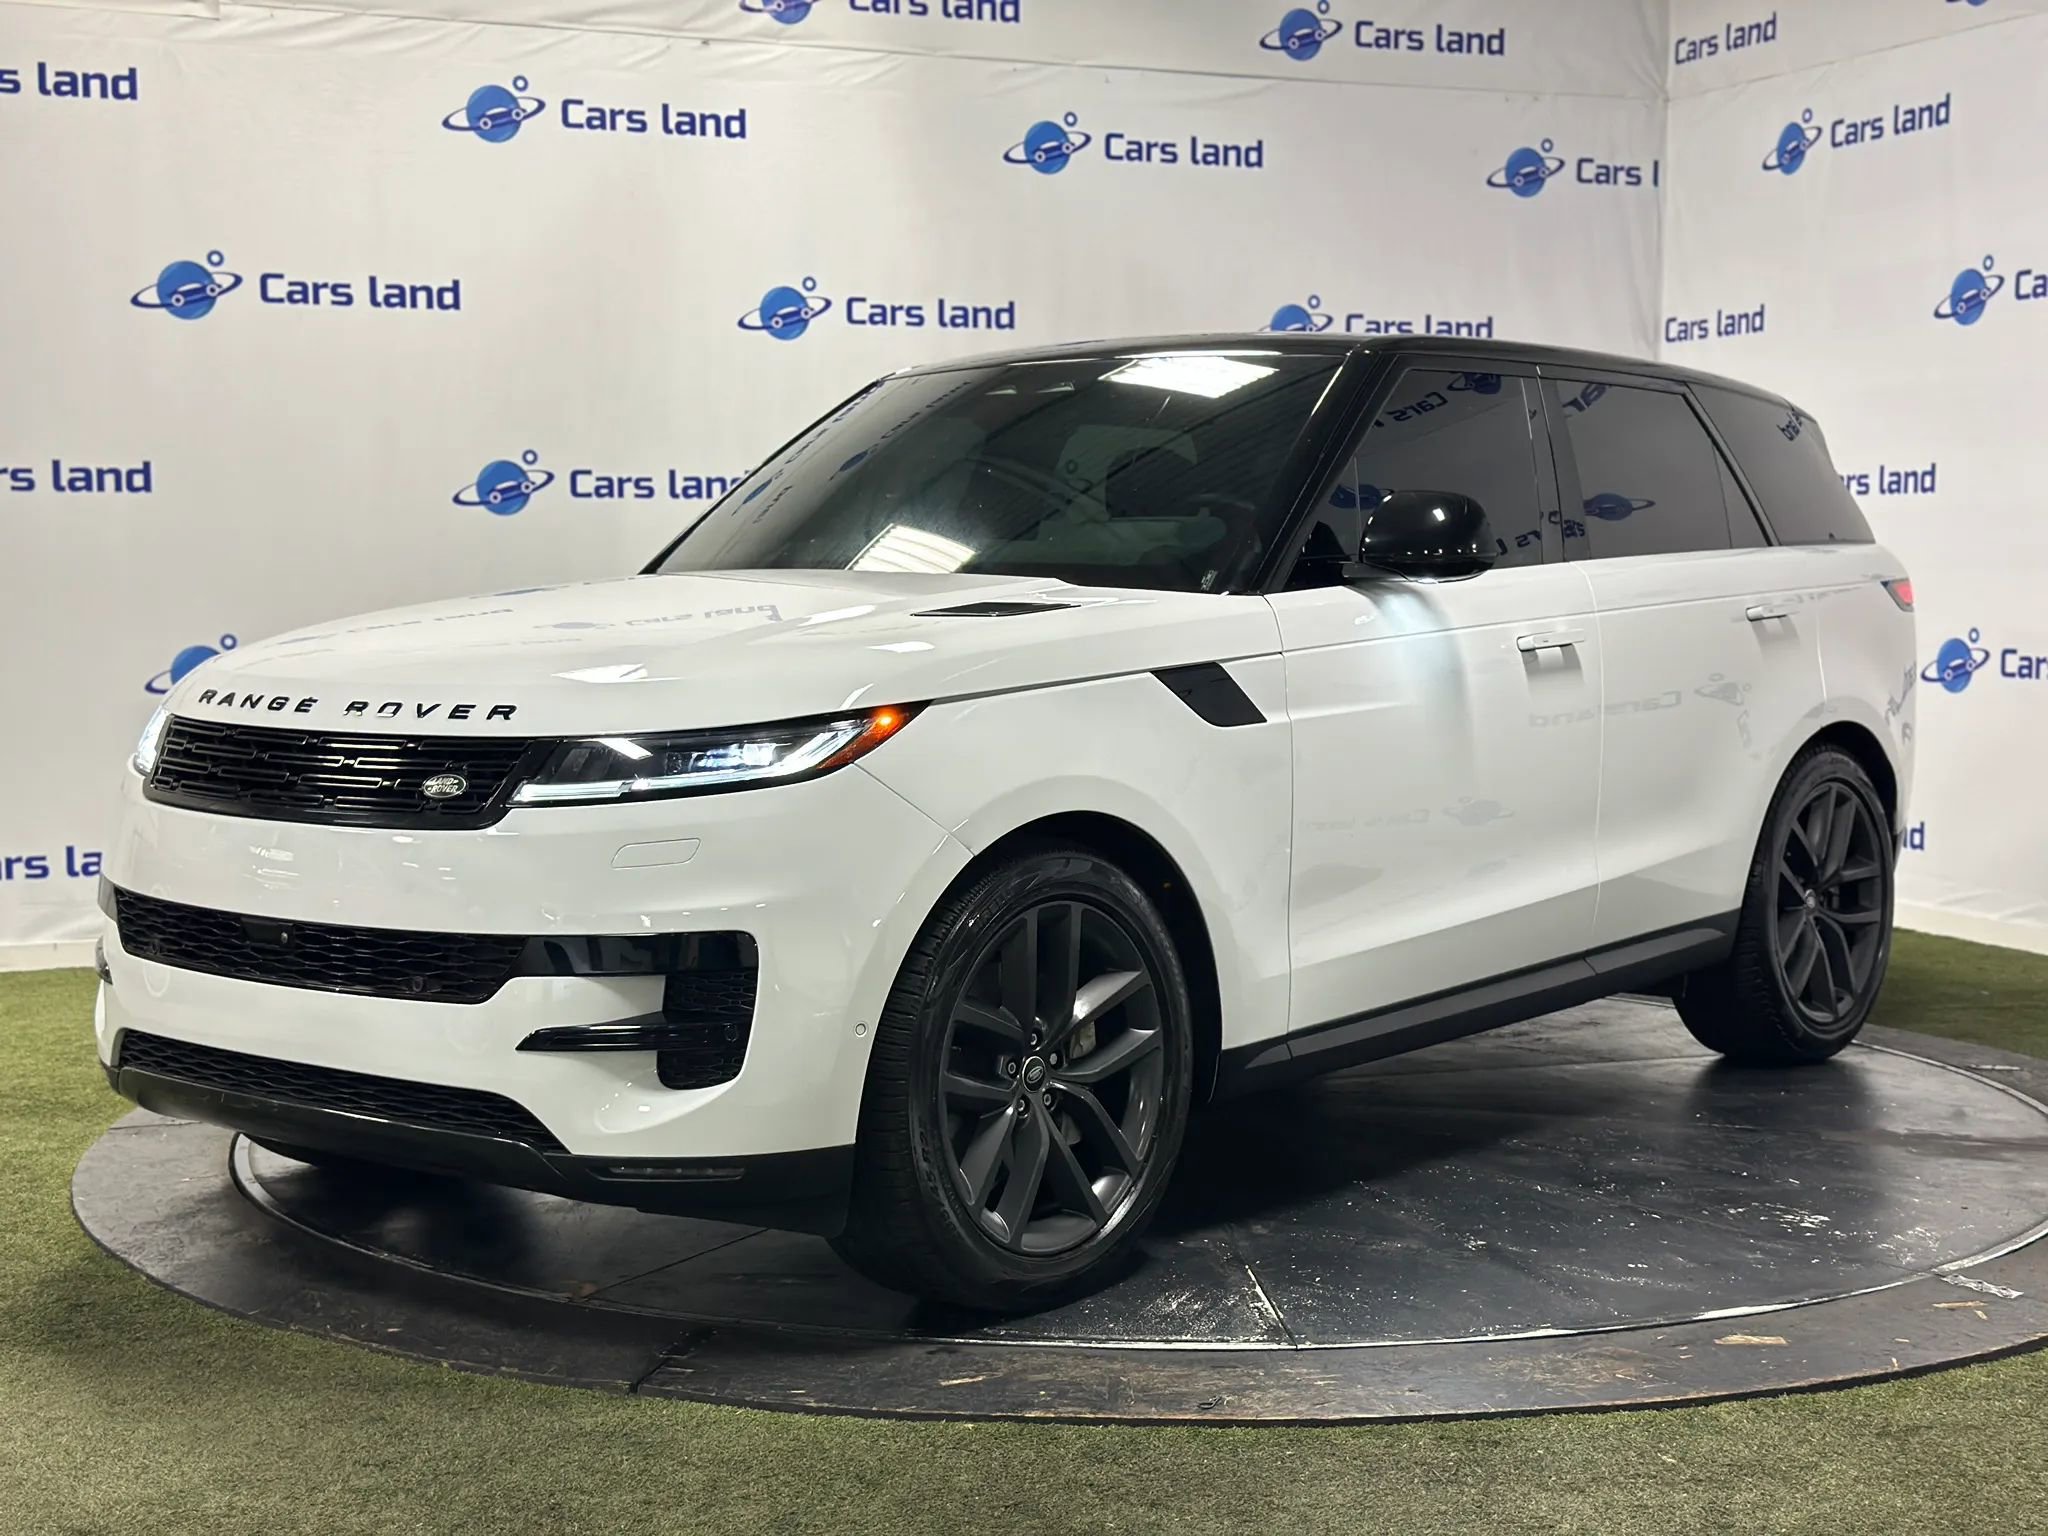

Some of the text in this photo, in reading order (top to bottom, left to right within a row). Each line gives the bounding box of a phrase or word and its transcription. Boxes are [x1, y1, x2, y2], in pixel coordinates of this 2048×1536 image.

[1354, 21, 1505, 55] Cars land
[1674, 12, 1777, 65] Cars land
[37, 62, 138, 101] land
[561, 98, 747, 139] Cars land
[1830, 93, 1951, 149] Cars land
[1104, 133, 1263, 168] Cars land
[1576, 157, 1642, 186] Cars
[259, 272, 461, 311] Cars land
[846, 297, 1015, 330] Cars land
[1664, 304, 1765, 343] Cars land
[52, 459, 152, 493] land
[569, 469, 750, 499] Cars lan
[1879, 462, 1937, 495] land
[2001, 648, 2048, 680] Car
[198, 689, 517, 721] RANGE ROVER
